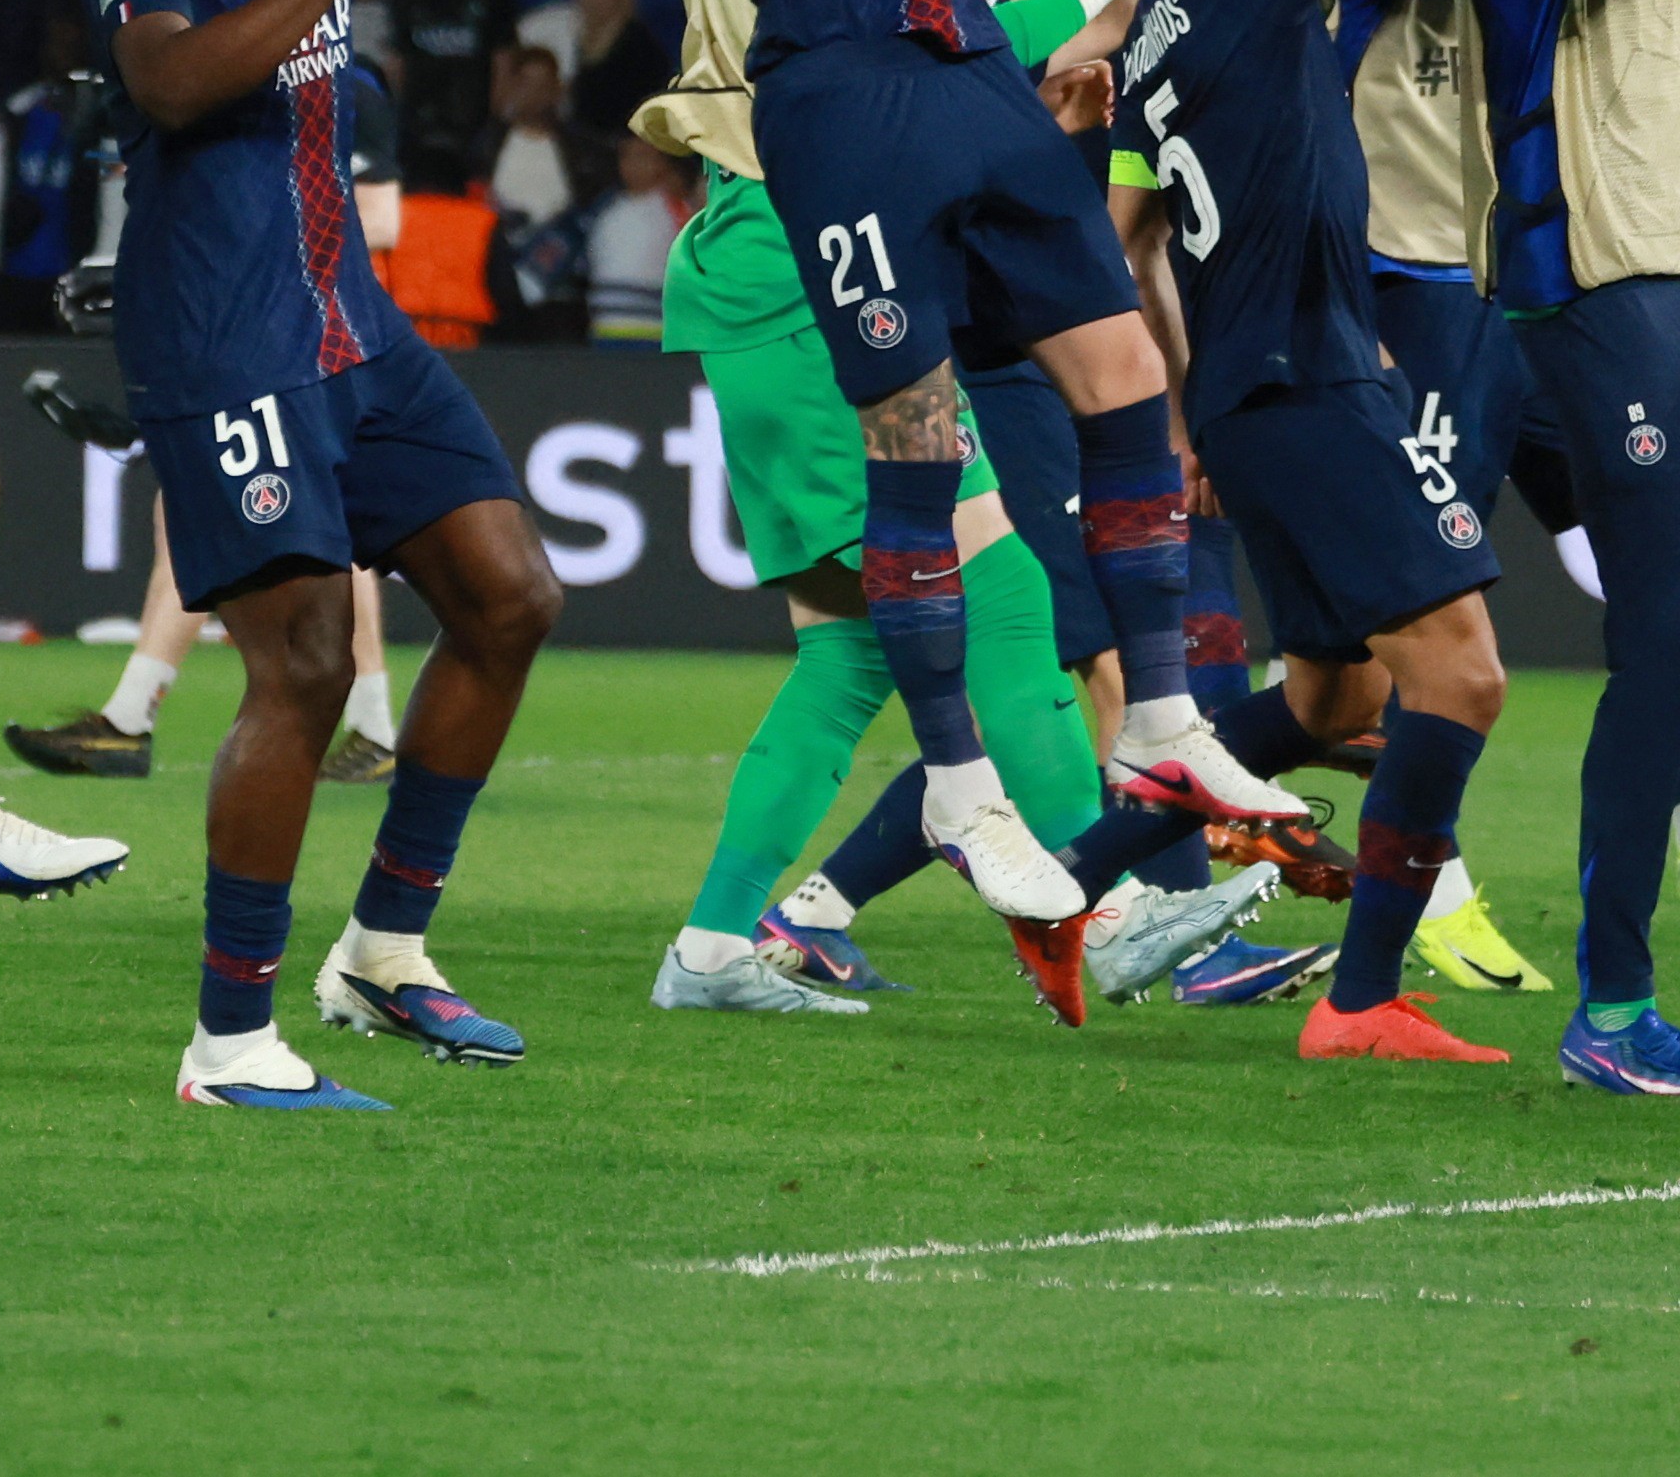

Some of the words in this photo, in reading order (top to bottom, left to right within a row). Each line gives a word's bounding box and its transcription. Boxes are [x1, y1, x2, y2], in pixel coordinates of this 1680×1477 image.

[1145, 78, 1220, 263] 5
[818, 212, 897, 309] 21
[213, 394, 291, 477] 51
[1418, 390, 1460, 464] 4
[1627, 401, 1647, 424] 89
[1398, 436, 1458, 505] 5
